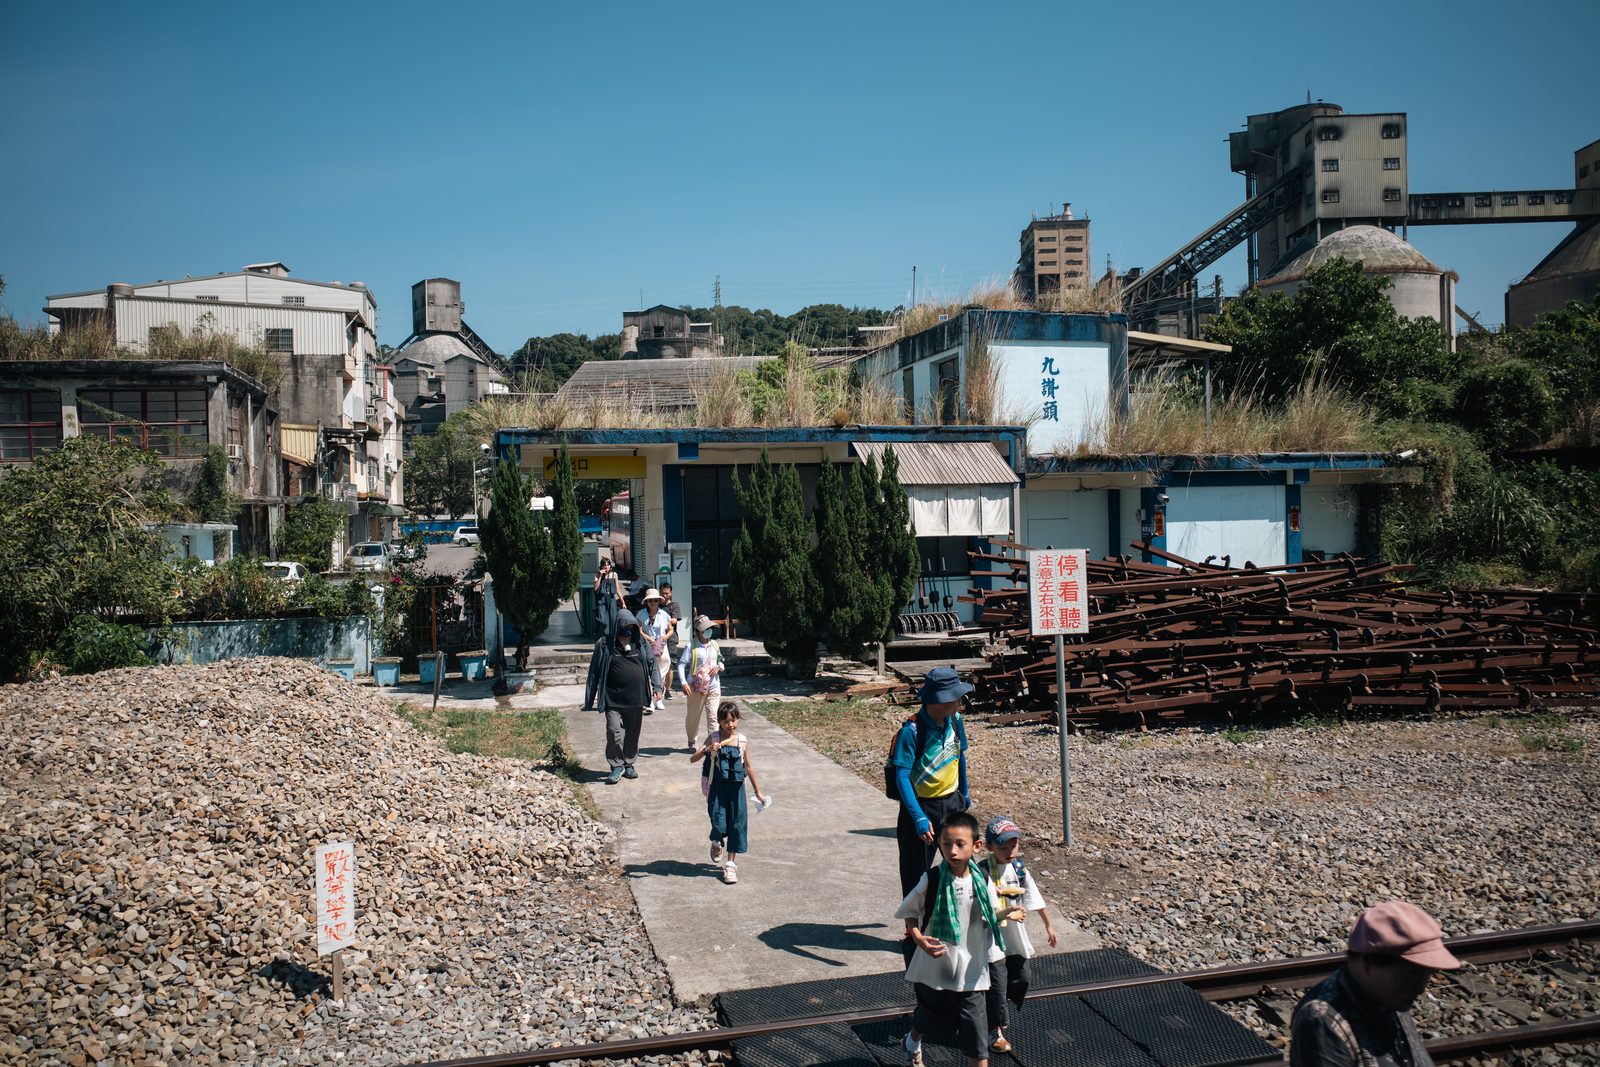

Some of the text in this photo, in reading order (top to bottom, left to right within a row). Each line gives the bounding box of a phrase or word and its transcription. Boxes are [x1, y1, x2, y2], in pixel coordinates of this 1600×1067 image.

[1041, 356, 1060, 422] 九讚頭
[1037, 554, 1055, 630] 注意左右來車
[1057, 554, 1081, 629] 停看聽
